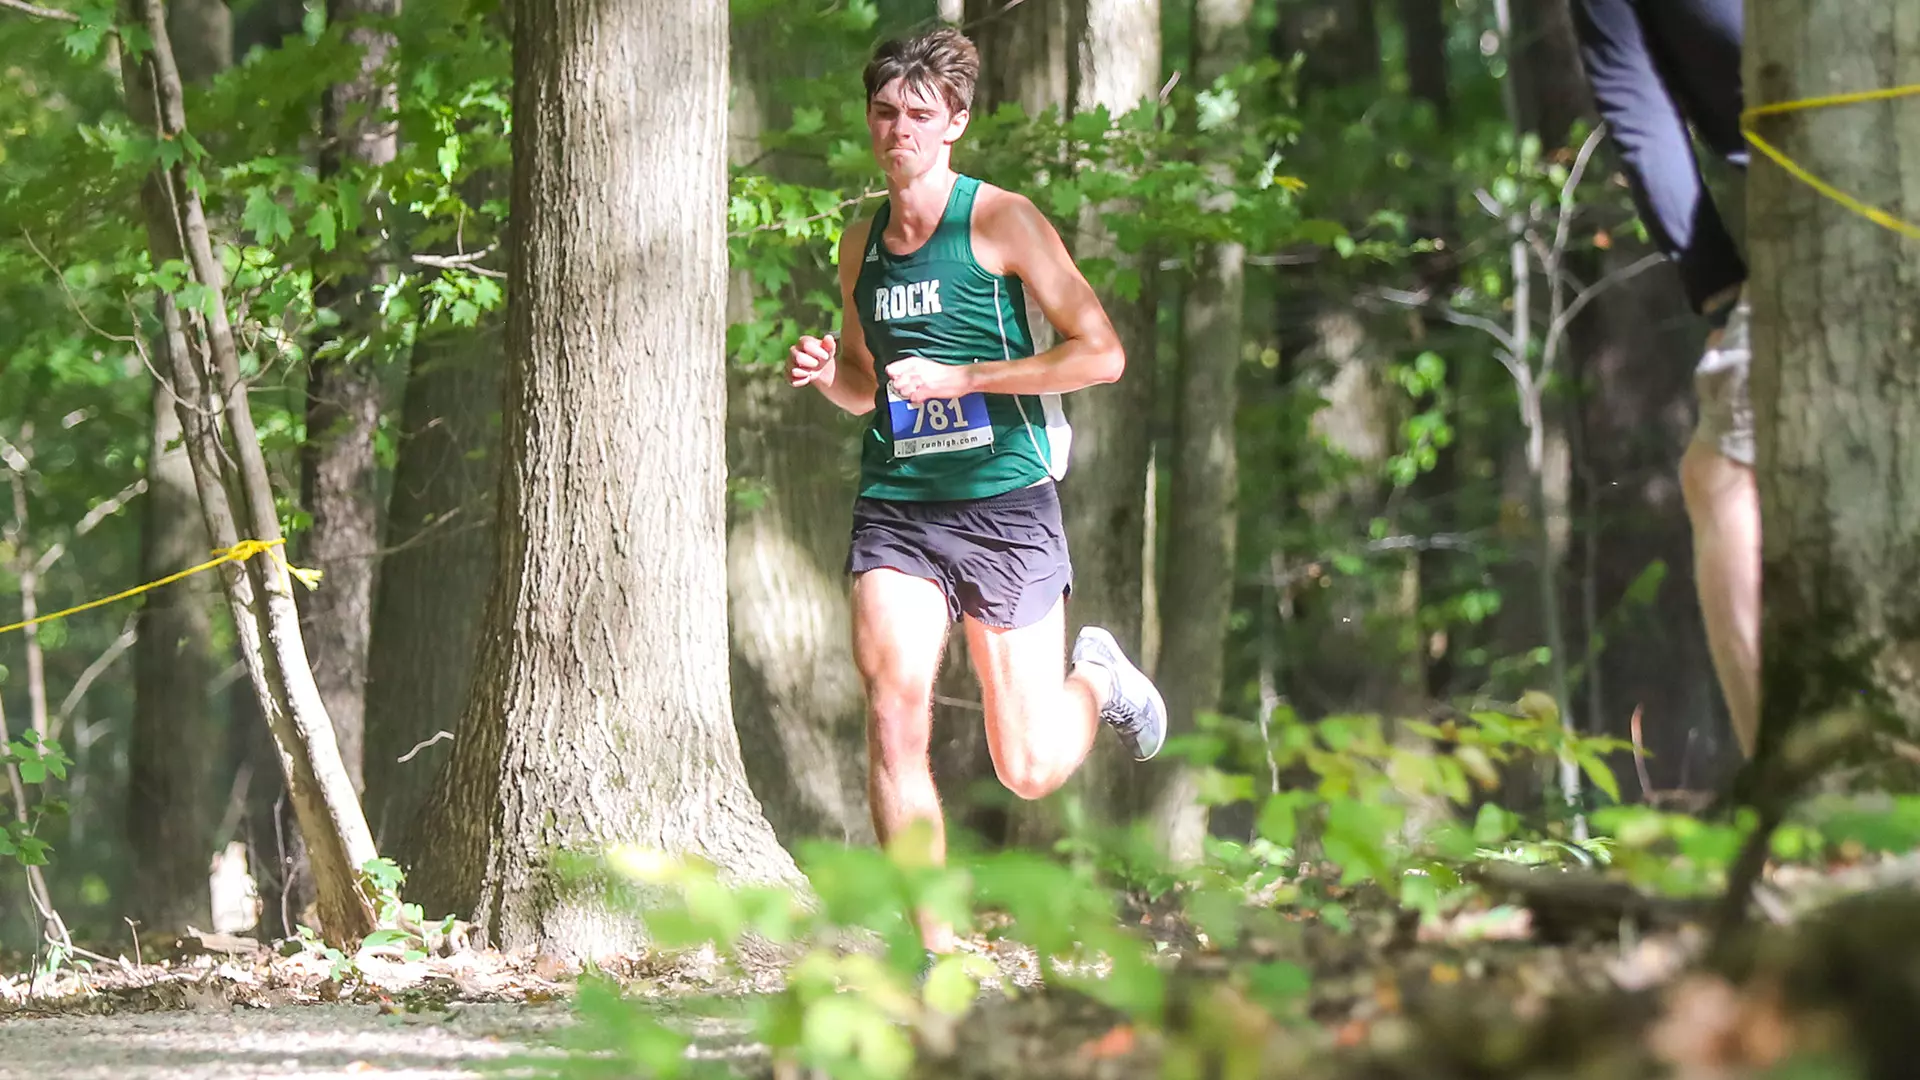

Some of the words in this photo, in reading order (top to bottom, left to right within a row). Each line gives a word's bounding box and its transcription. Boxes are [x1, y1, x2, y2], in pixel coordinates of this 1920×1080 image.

[874, 279, 942, 322] ROCK
[906, 397, 969, 434] 781
[921, 436, 979, 449] runhigh.com
